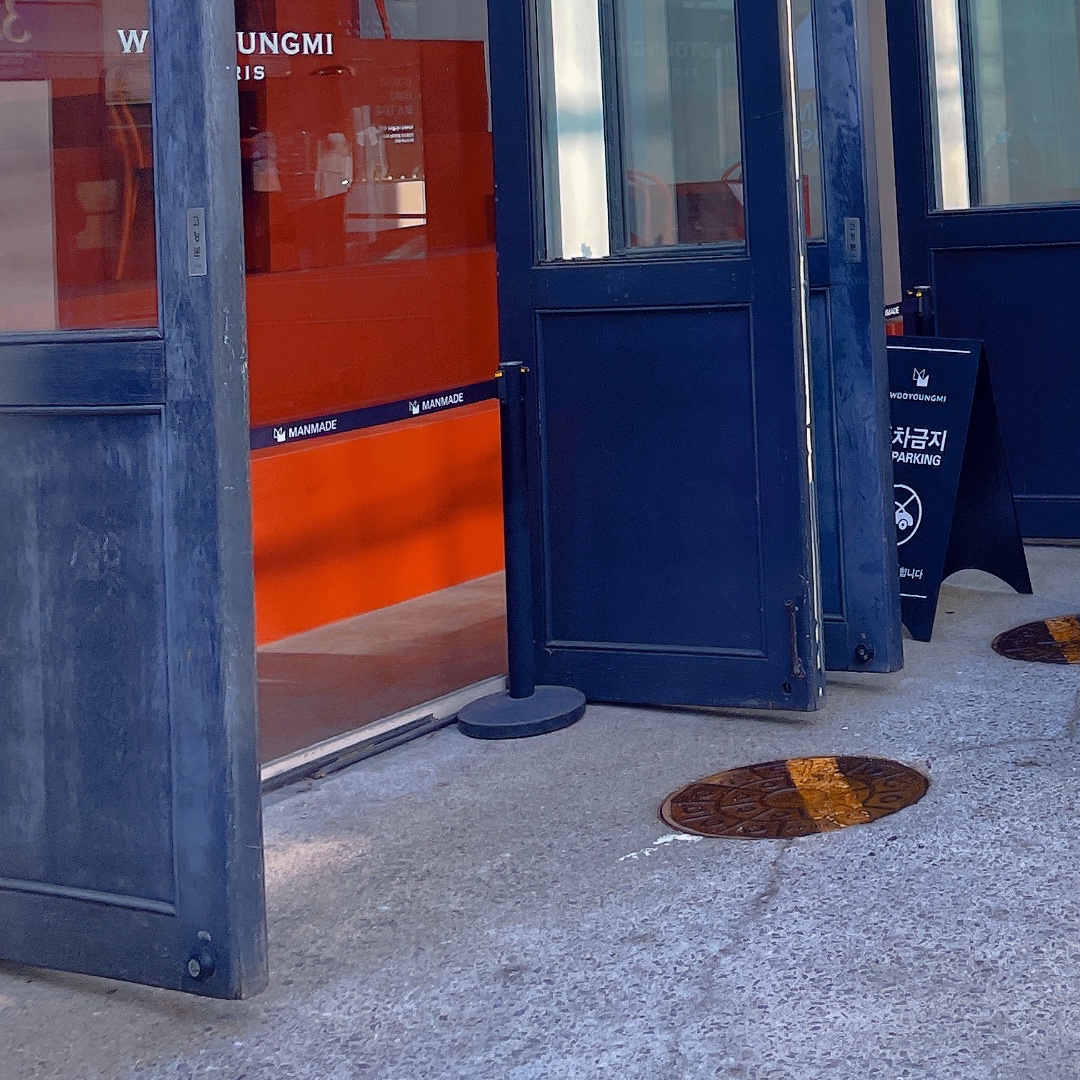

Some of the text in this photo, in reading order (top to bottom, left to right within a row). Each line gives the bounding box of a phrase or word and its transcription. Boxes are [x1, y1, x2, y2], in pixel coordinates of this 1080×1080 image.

[117, 29, 333, 55] WUNGMI
[422, 393, 464, 410] MANMADE
[889, 391, 947, 403] WOOYOUNGMI
[288, 419, 337, 438] MANMADE
[889, 426, 948, 452] 차금지
[891, 450, 942, 466] PARKING
